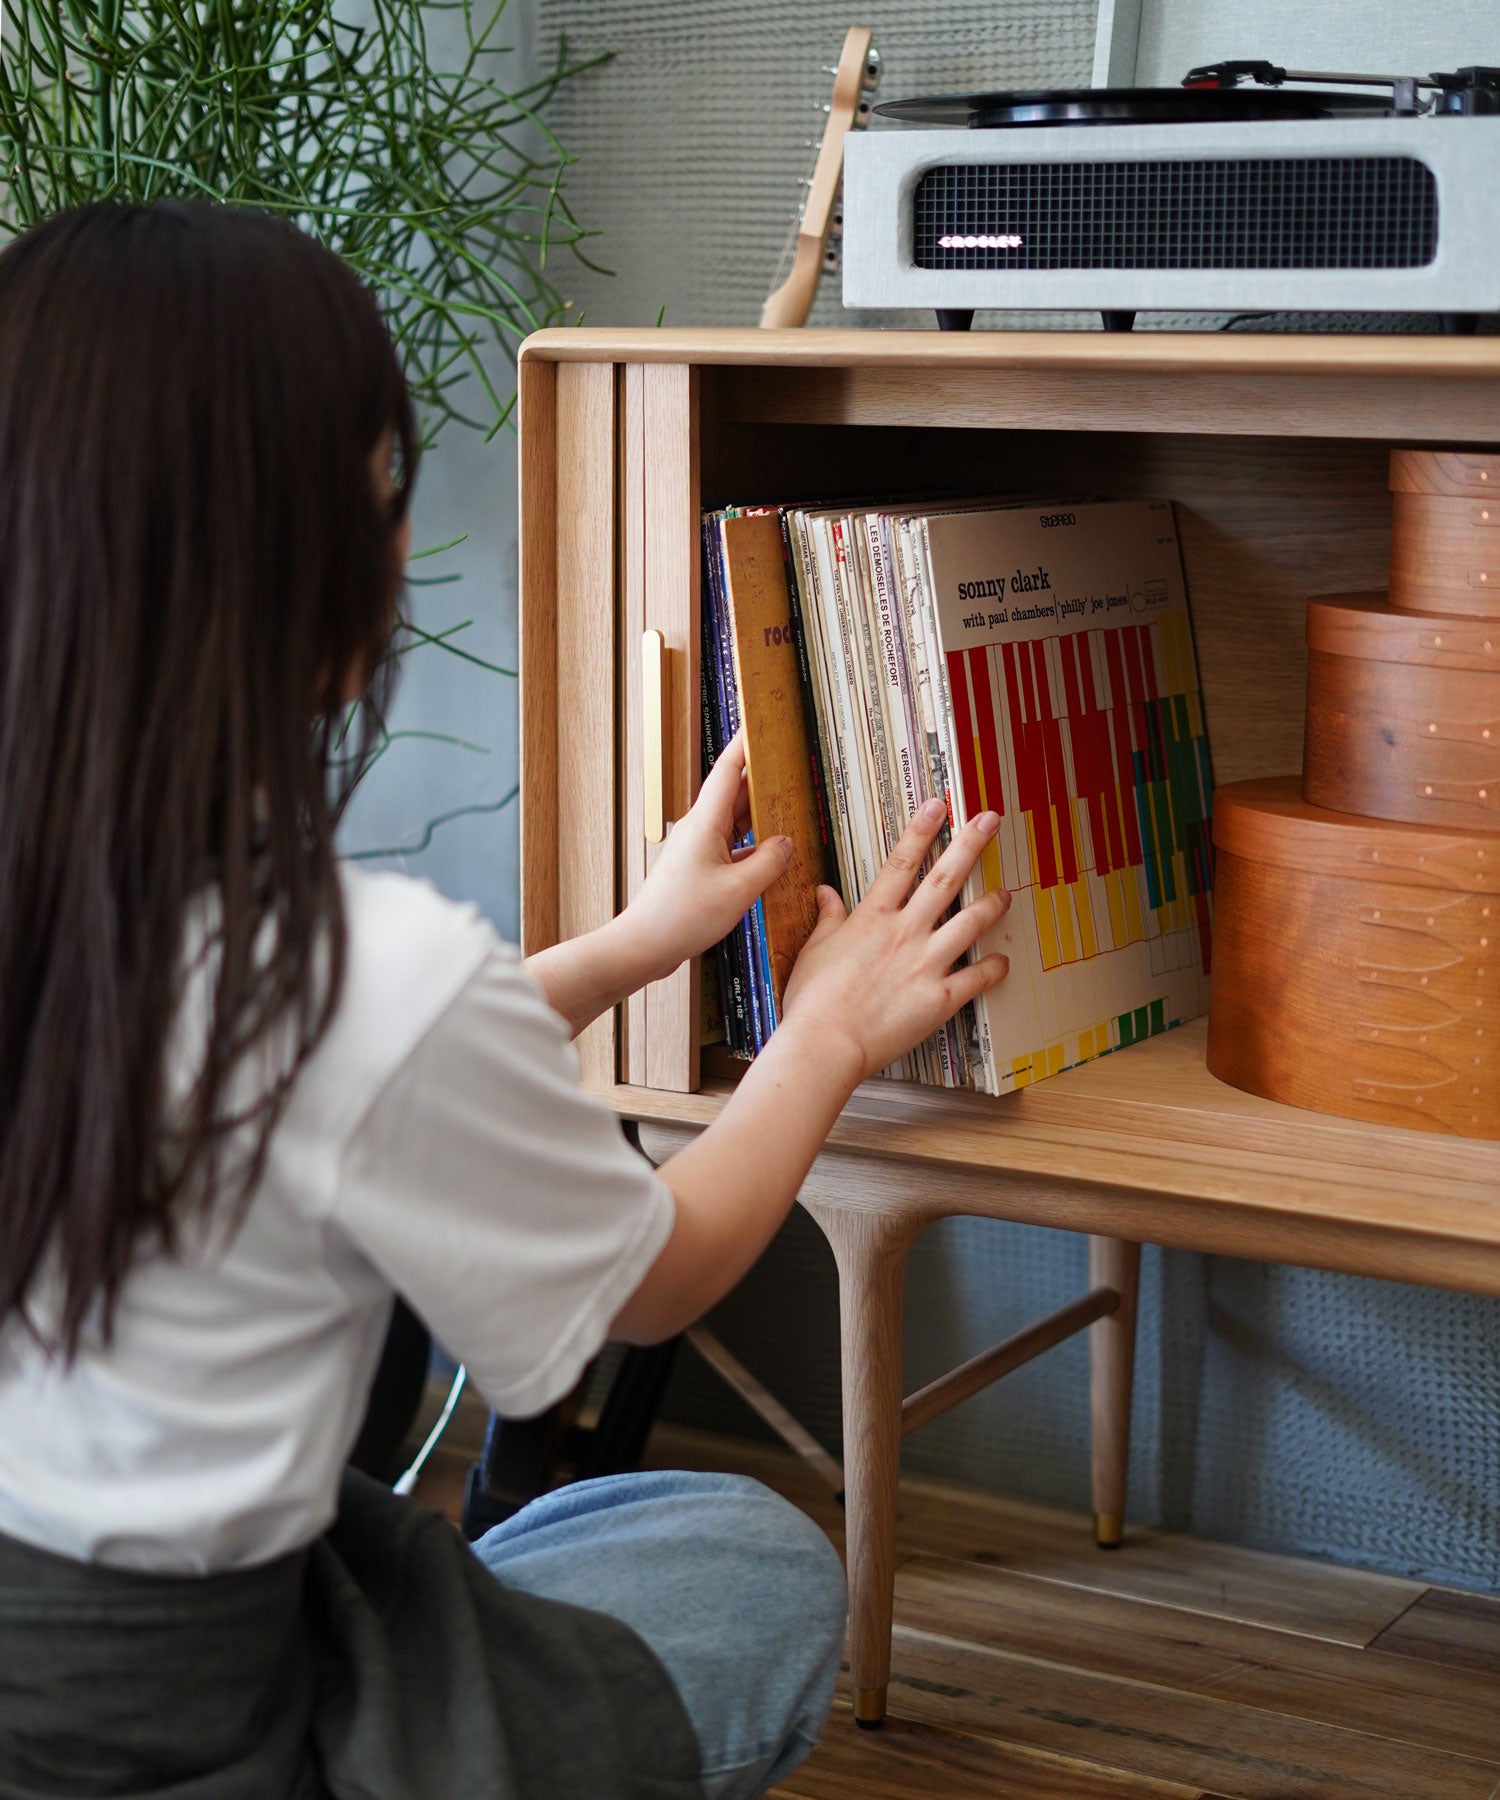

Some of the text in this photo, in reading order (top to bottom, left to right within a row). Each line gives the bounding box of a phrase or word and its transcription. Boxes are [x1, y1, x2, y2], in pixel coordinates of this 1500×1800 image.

[869, 525, 879, 543] LES
[873, 546, 888, 612] DEMOISELLES
[958, 567, 1051, 602] sonny clark
[882, 613, 890, 627] DE
[963, 611, 986, 629] with
[988, 609, 1009, 629] paul
[1011, 604, 1055, 622] chambers
[1090, 596, 1104, 613] joe
[1105, 594, 1128, 610] jones
[839, 608, 850, 655] UNDERGROUND
[846, 660, 854, 686] LOADED
[884, 629, 899, 688] ROCHEFORT
[703, 707, 714, 753] SPANKING
[875, 754, 883, 781] Charming
[900, 747, 912, 789] VERSION
[837, 787, 846, 815] HANCOCK
[732, 977, 744, 1019] GRLP 102
